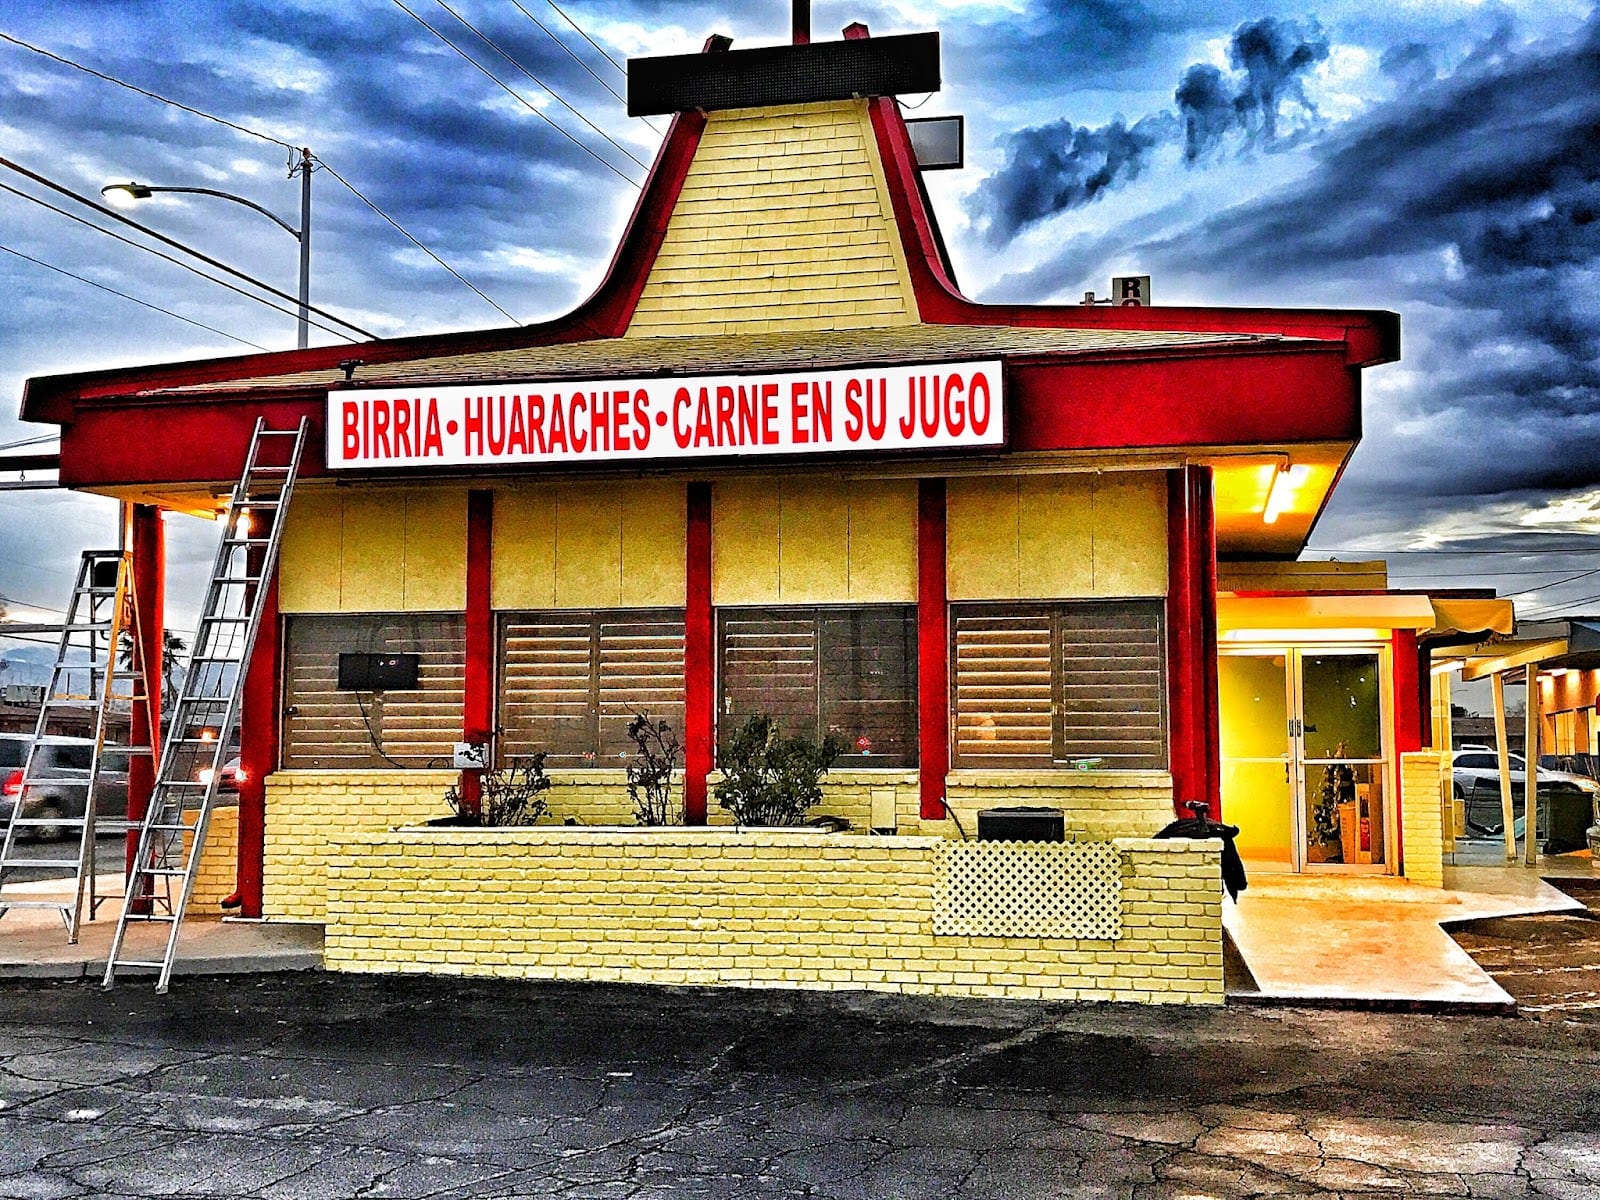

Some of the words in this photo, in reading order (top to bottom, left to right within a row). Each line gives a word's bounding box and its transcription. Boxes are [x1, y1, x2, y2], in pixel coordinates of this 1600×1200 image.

[342, 397, 443, 460] BIRRIA
[465, 388, 650, 456] HUARACHES
[673, 383, 780, 449] CARNE
[791, 381, 833, 443] EN
[845, 378, 887, 442] SU
[899, 372, 990, 440] JUGO
